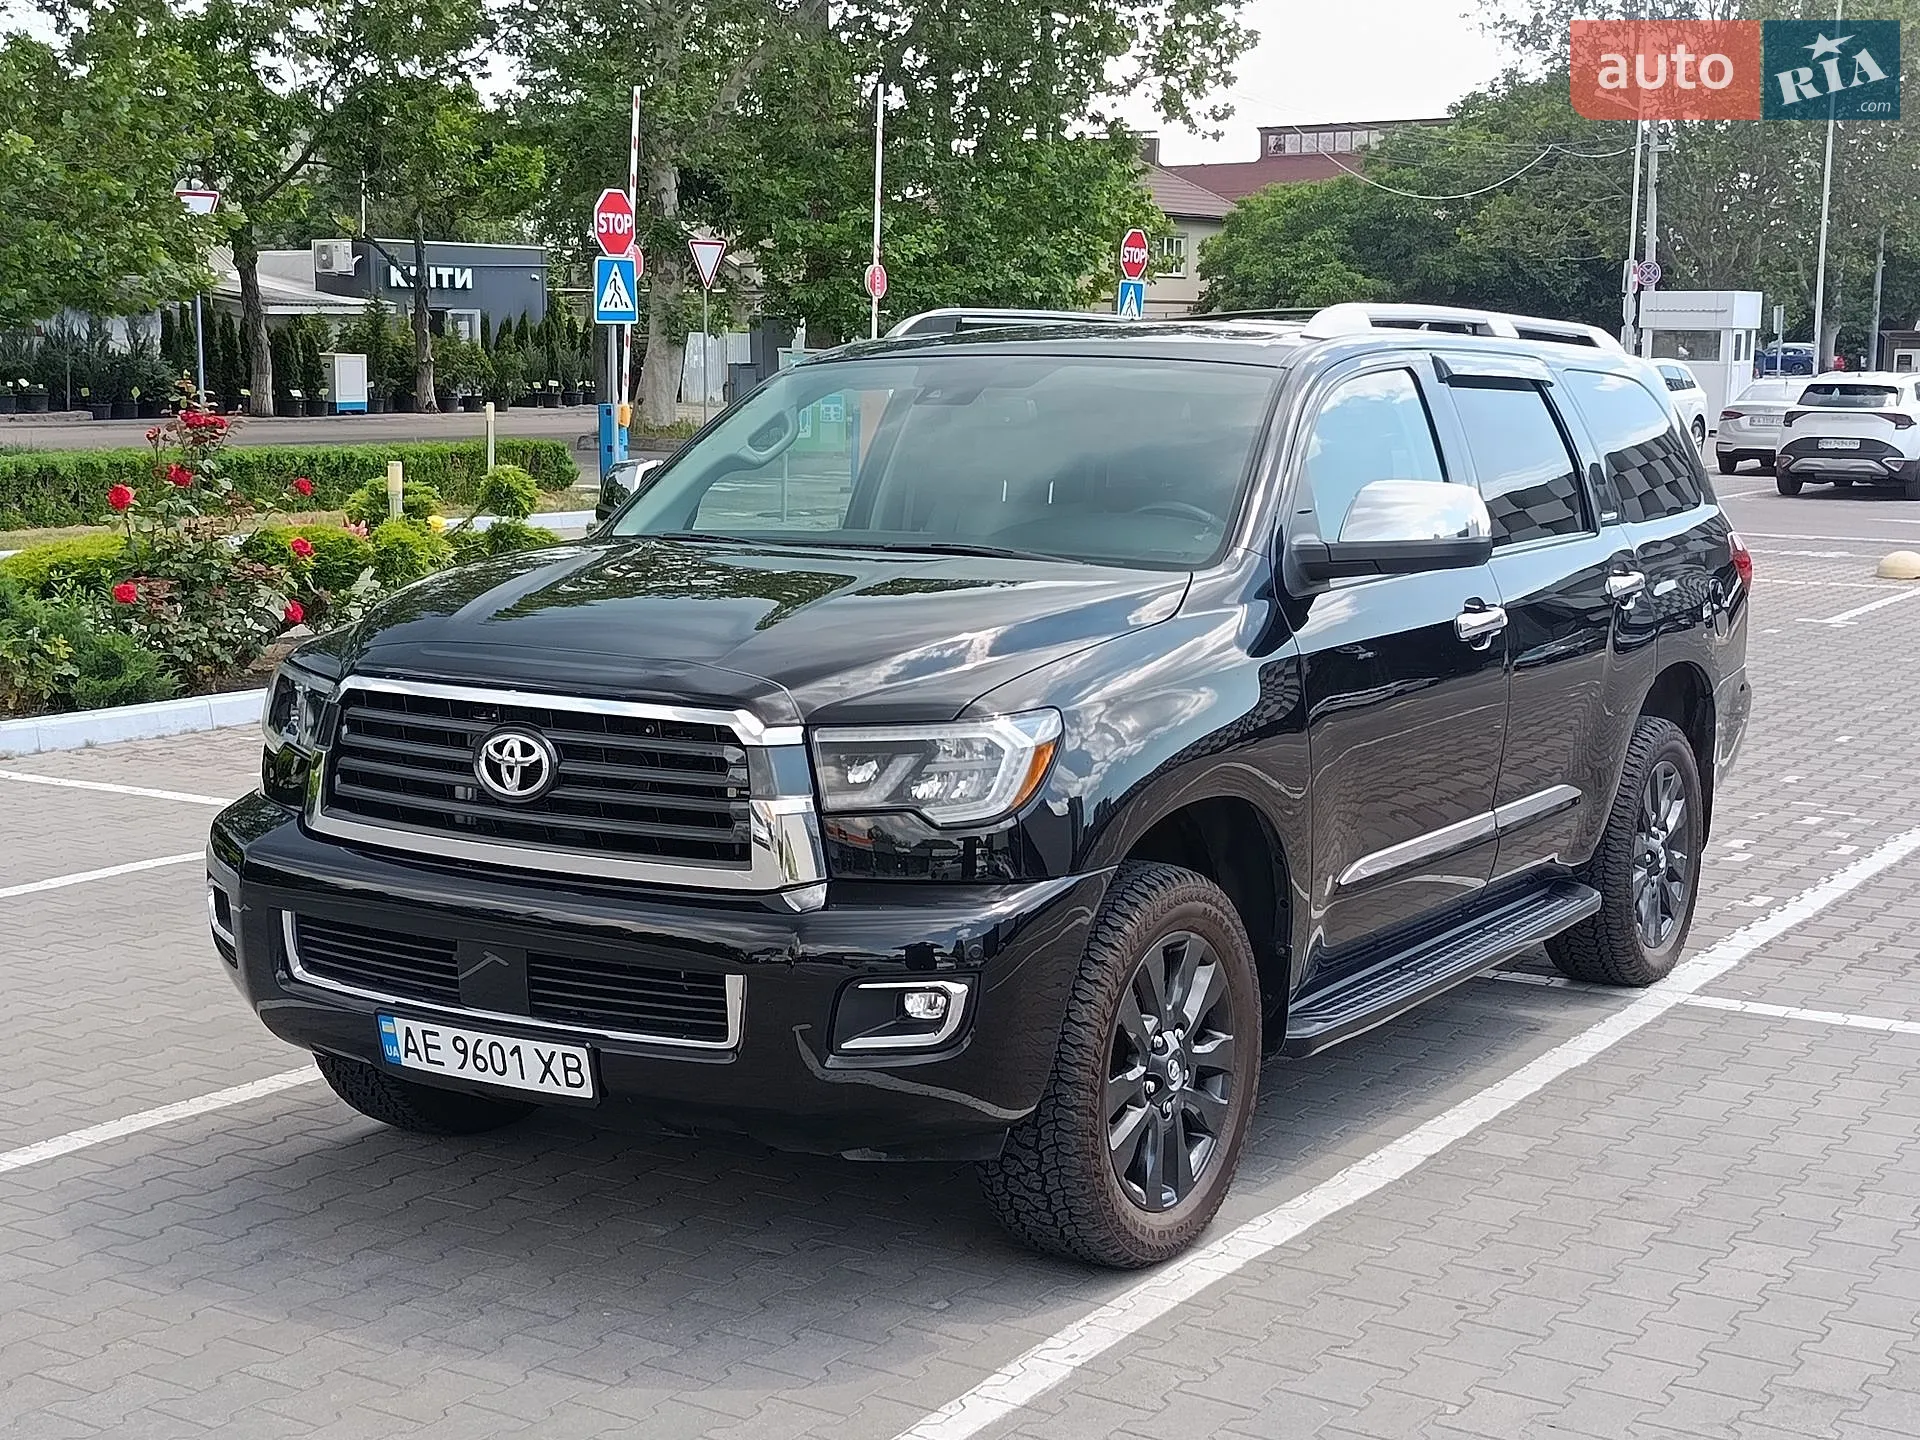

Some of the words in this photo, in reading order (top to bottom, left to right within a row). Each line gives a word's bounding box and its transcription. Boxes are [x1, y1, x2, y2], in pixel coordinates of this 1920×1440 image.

[598, 212, 633, 234] STOP
[1123, 246, 1146, 264] STOP
[384, 1044, 400, 1058] UA
[403, 1026, 446, 1067] AE
[452, 1035, 526, 1081] 9601
[533, 1047, 586, 1089] XB
